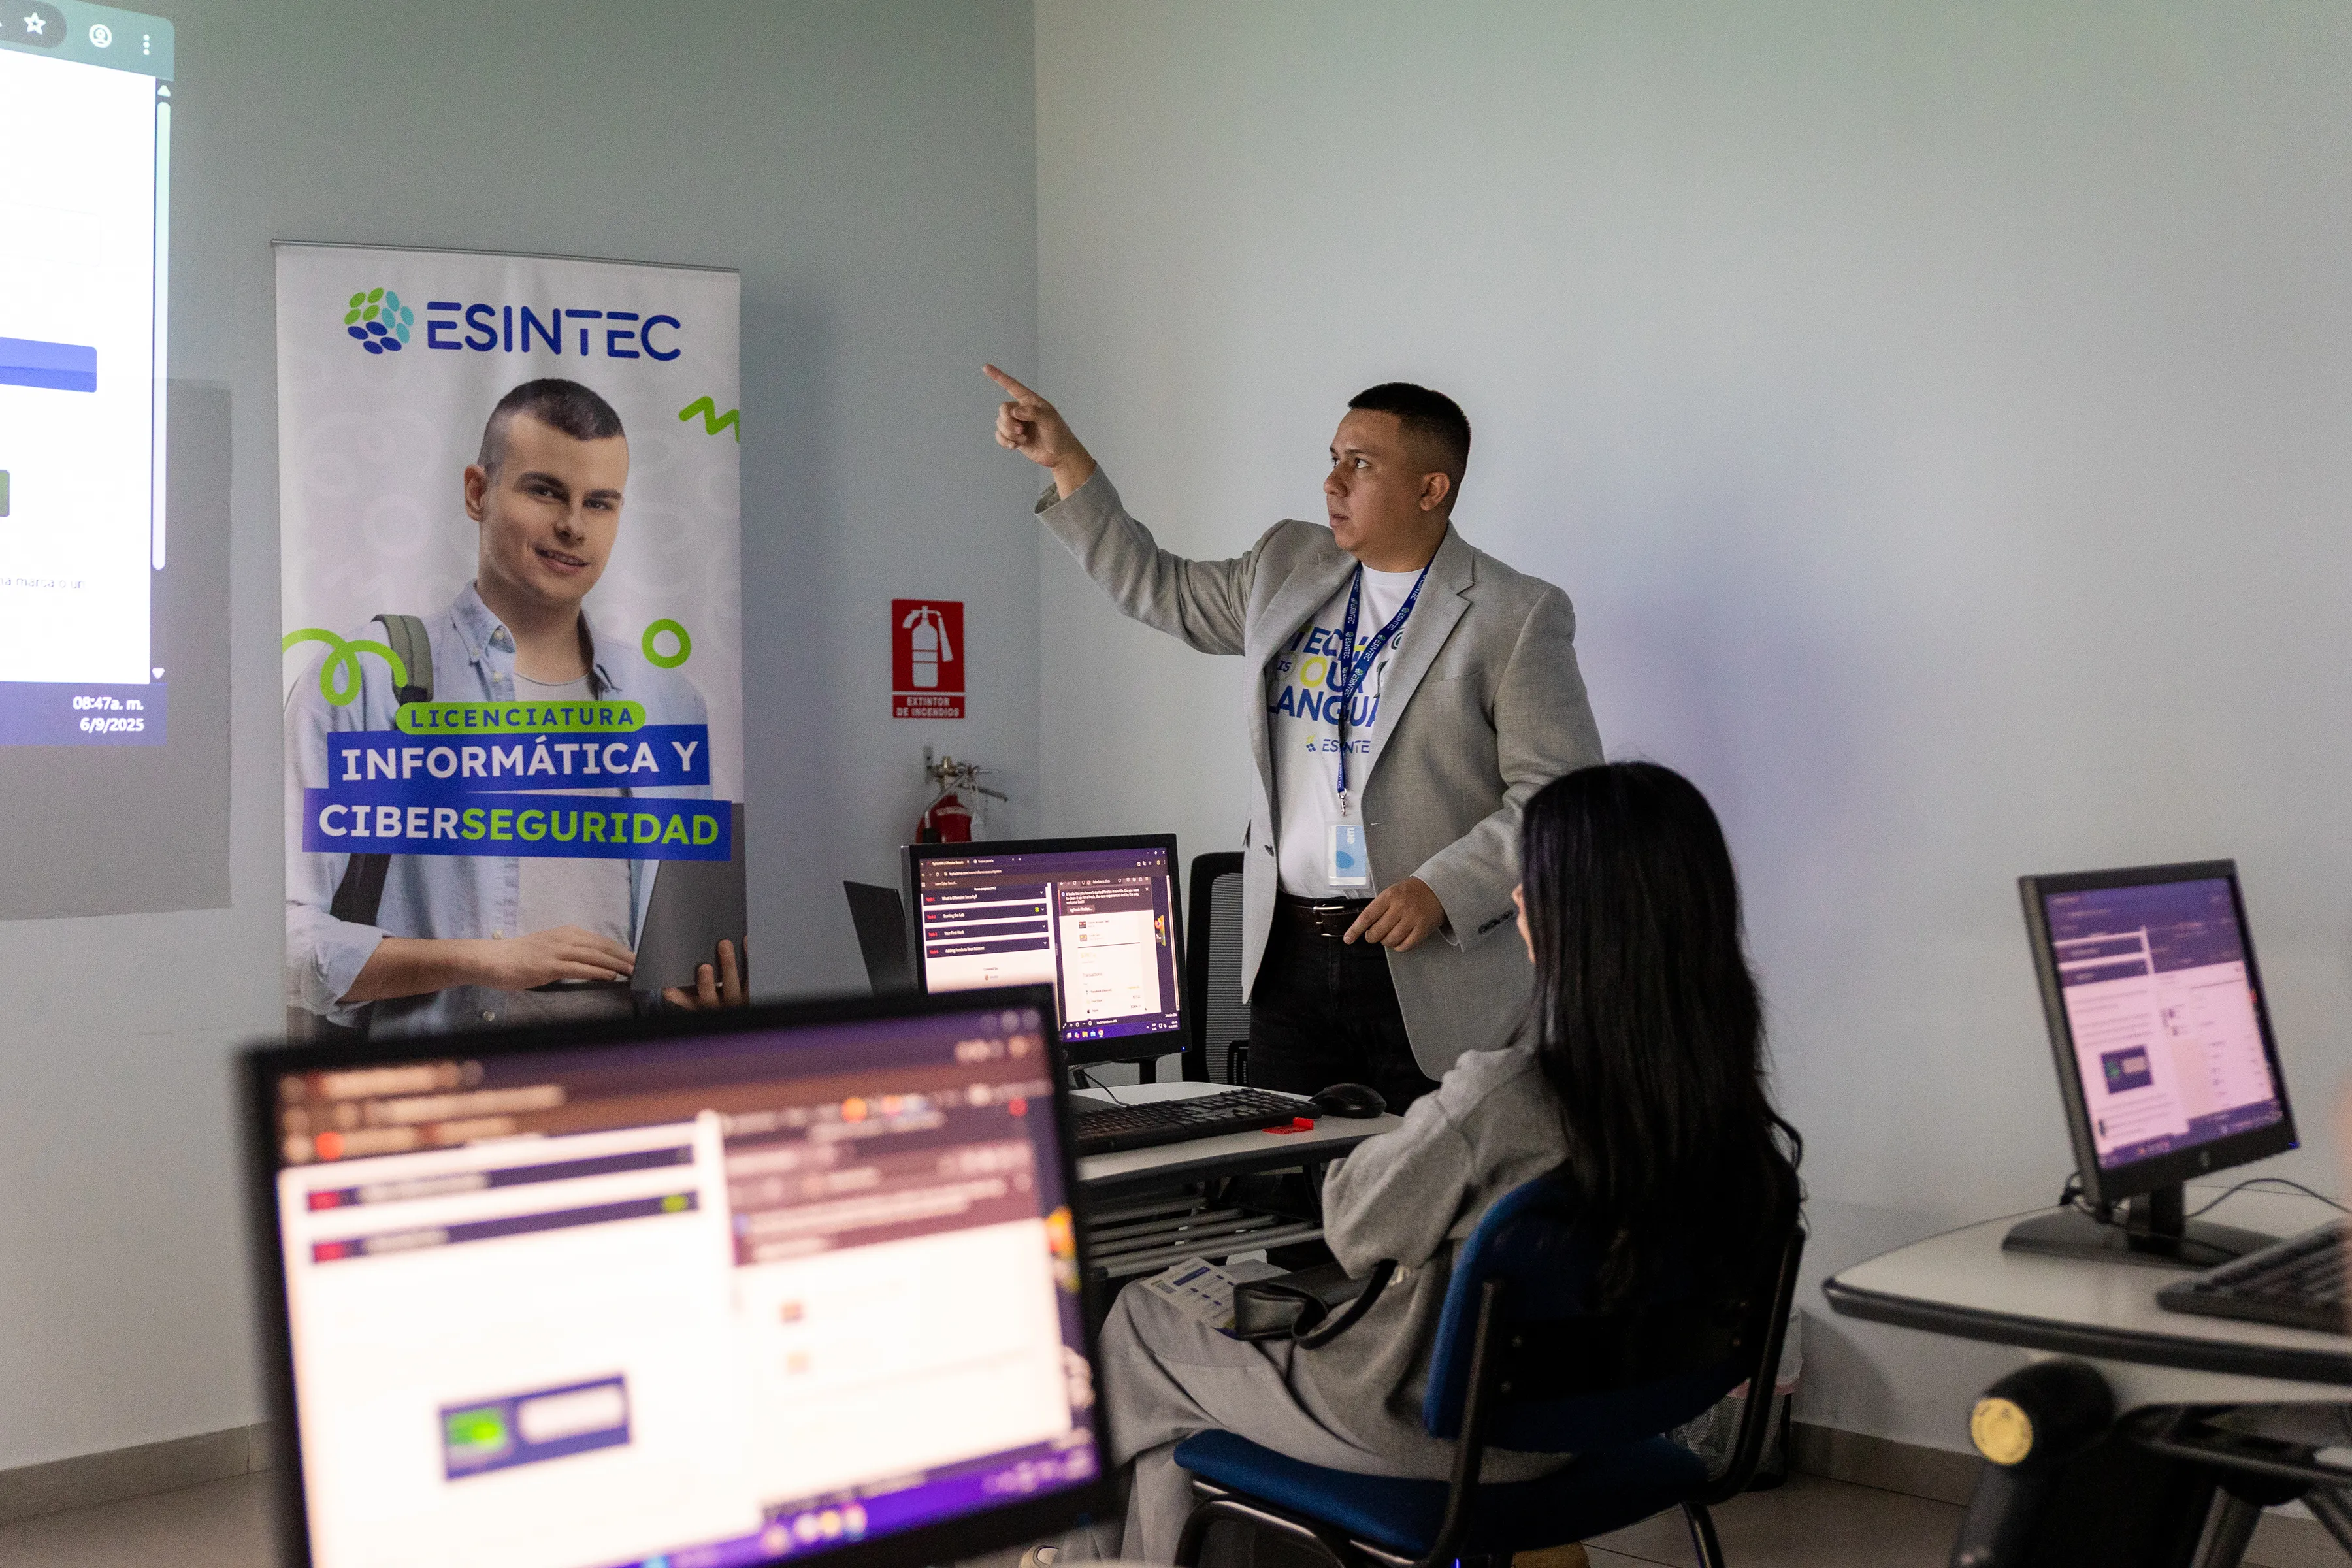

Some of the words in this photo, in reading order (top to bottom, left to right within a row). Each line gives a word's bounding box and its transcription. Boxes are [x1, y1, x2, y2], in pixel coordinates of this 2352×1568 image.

[427, 301, 681, 361] ESINTEC
[1343, 638, 1352, 659] ESINTEC
[1364, 639, 1382, 662] ESINTEC
[1277, 659, 1292, 672] IS
[1300, 656, 1364, 694] OU
[1344, 674, 1360, 698] ESINTEC
[896, 707, 909, 717] DE
[911, 707, 960, 717] INCENDIOS
[907, 696, 950, 706] EXTINTOR
[1268, 685, 1380, 727] ANGU
[79, 717, 145, 734] 6/9/2025
[410, 708, 634, 728] LICENCIATURA
[1322, 739, 1371, 753] ESNTE
[341, 734, 660, 781] INFORMÁTICA
[670, 740, 698, 772] Y
[319, 804, 719, 846] CIBERSEGURIDAD
